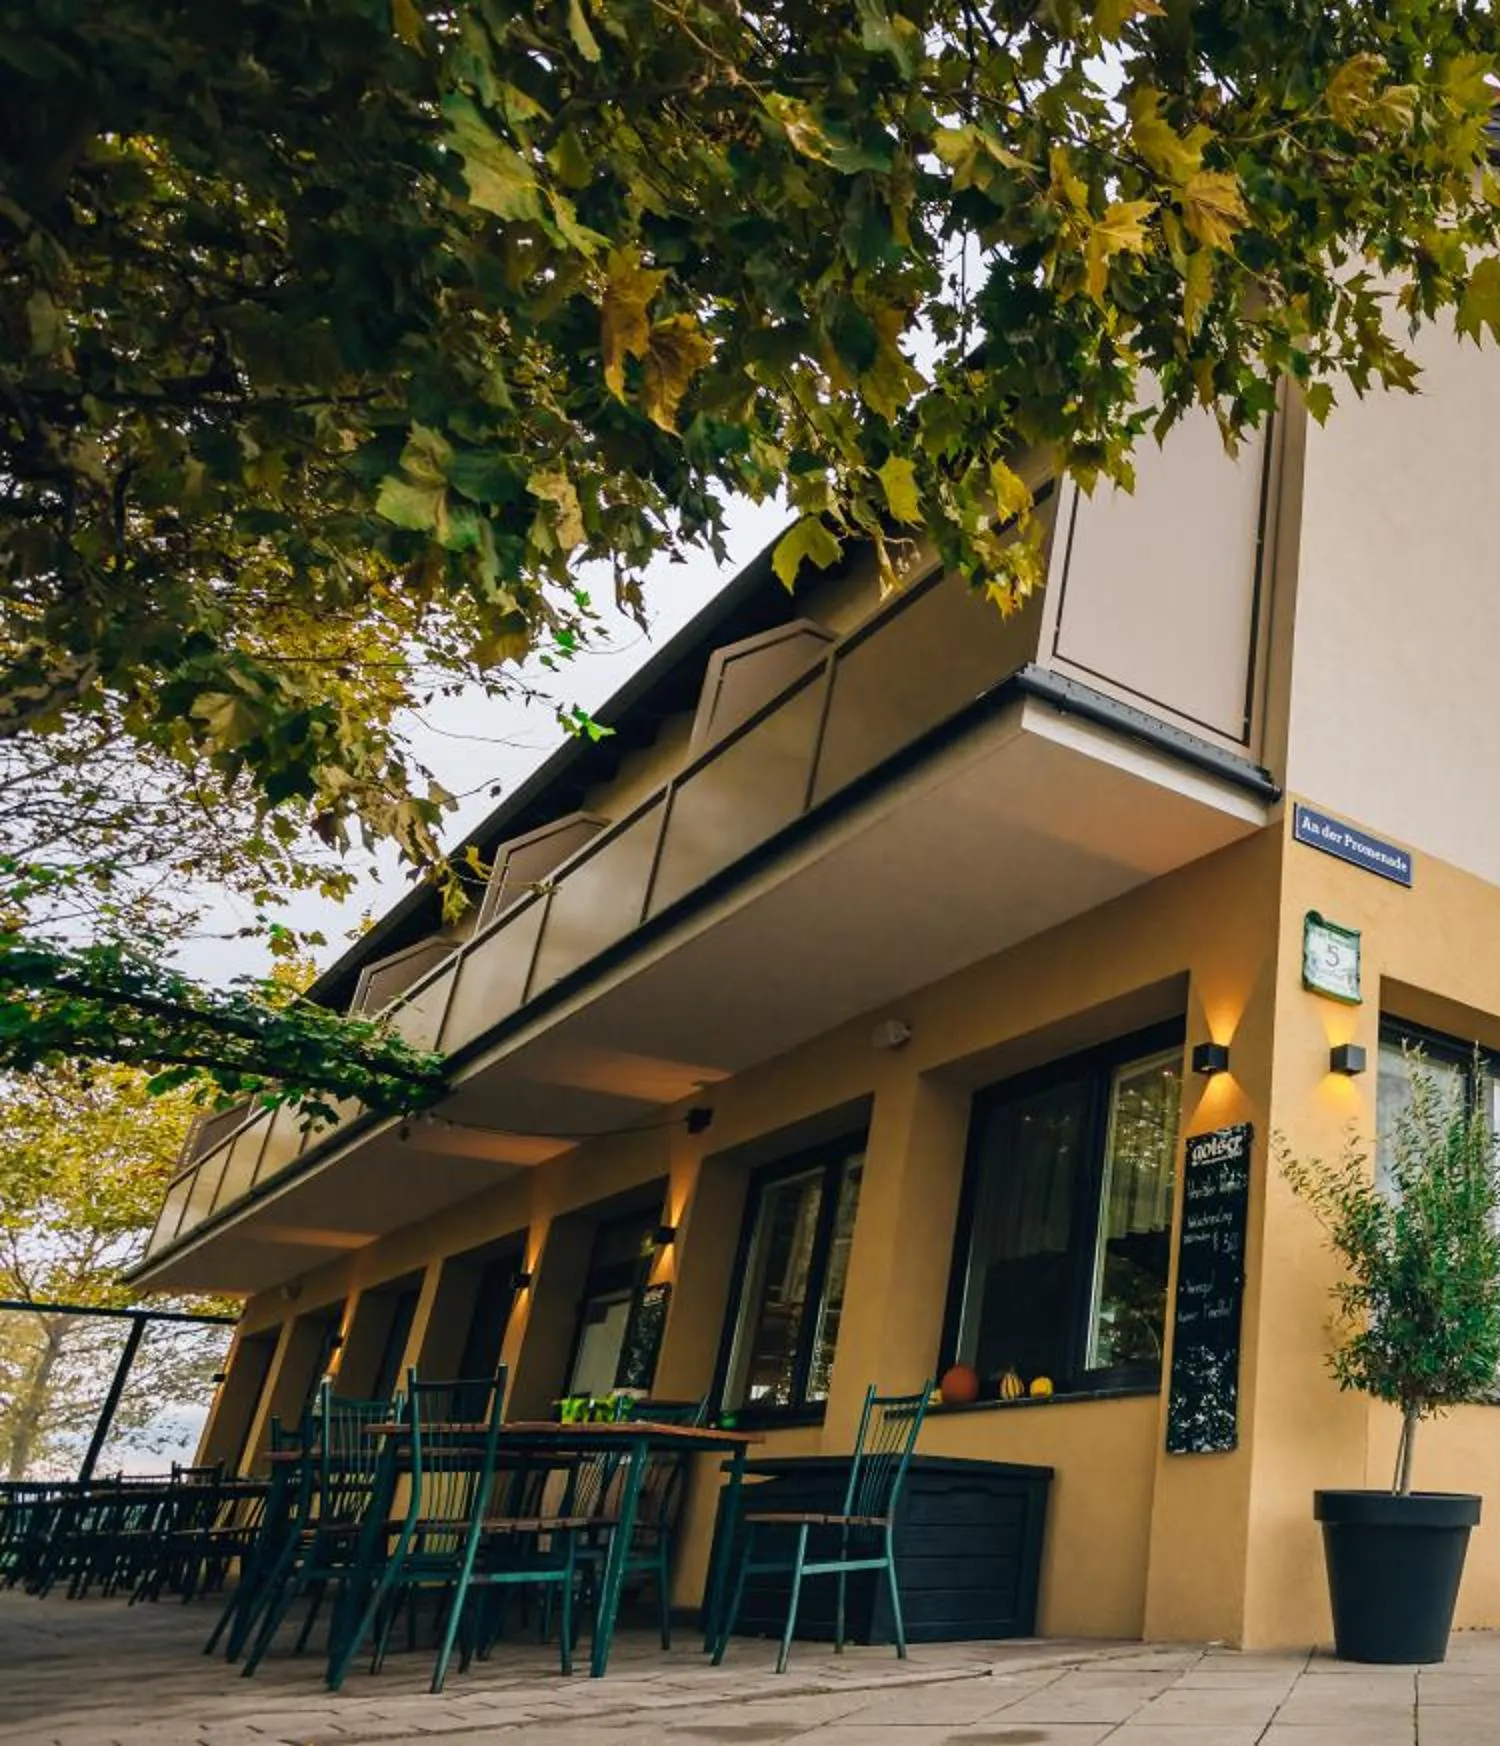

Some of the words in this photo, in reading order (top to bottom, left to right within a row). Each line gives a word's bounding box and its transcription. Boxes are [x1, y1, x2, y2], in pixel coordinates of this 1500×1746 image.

[1302, 816, 1320, 834] An
[1321, 824, 1342, 843] der
[1343, 834, 1408, 873] Promenade
[1325, 944, 1340, 968] 5
